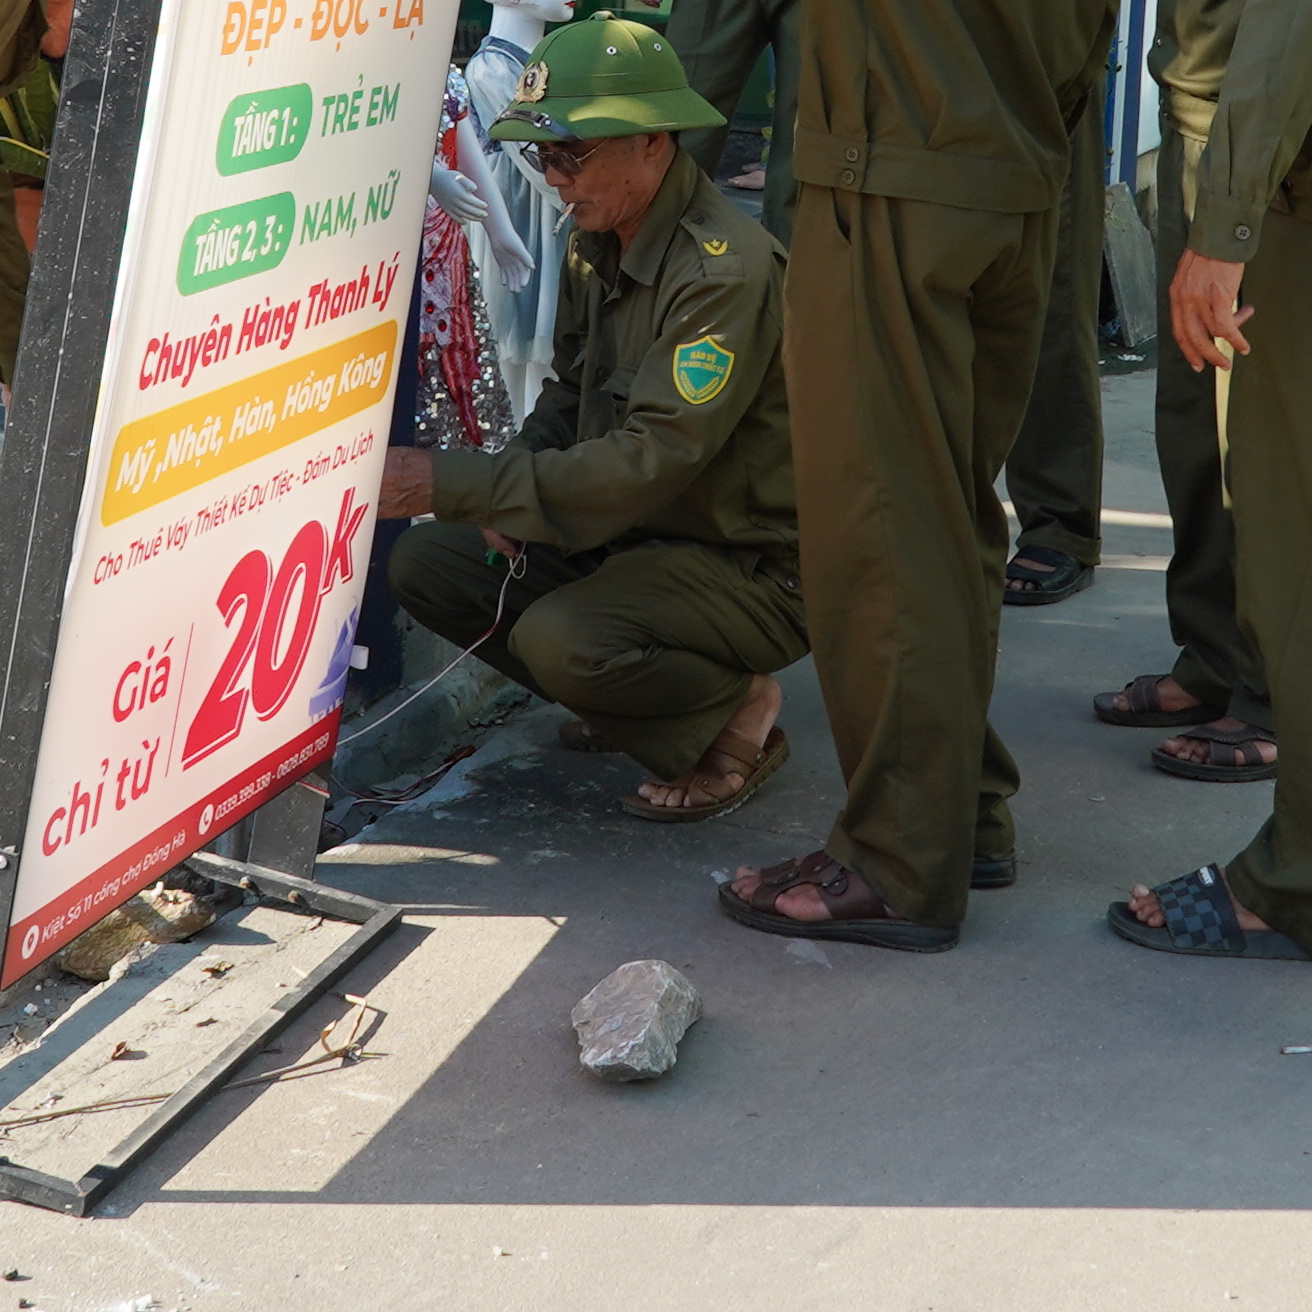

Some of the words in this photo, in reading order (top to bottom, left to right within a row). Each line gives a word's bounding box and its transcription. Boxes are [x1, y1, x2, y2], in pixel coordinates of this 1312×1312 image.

[231, 100, 280, 158] TẦNG
[320, 73, 364, 138] TRẺ
[365, 82, 401, 128] EM
[192, 217, 243, 277] TẦNG
[299, 190, 358, 246] NAM,
[363, 168, 401, 226] NỮ
[139, 314, 234, 391] Chuyên
[236, 296, 301, 352] Hàng
[304, 263, 369, 331] Thanh
[371, 250, 401, 313] Lý
[114, 437, 156, 494] Mỹ
[228, 395, 277, 445] Hàn,
[280, 369, 337, 421] Hồng
[336, 348, 388, 397] Kông
[93, 549, 124, 586] Cho
[126, 528, 165, 571] Thuê
[166, 516, 194, 553] Váy
[193, 493, 230, 538] Thiết
[229, 484, 251, 521] Kế
[248, 479, 271, 514] Dự
[269, 468, 295, 503] Tiệc
[332, 445, 350, 471] Du
[349, 428, 375, 465] Lịch
[111, 635, 176, 724] Giá
[42, 757, 110, 857] chỉ
[114, 736, 162, 811] từ
[40, 914, 66, 944] Kiệt
[170, 828, 187, 852] Hà
